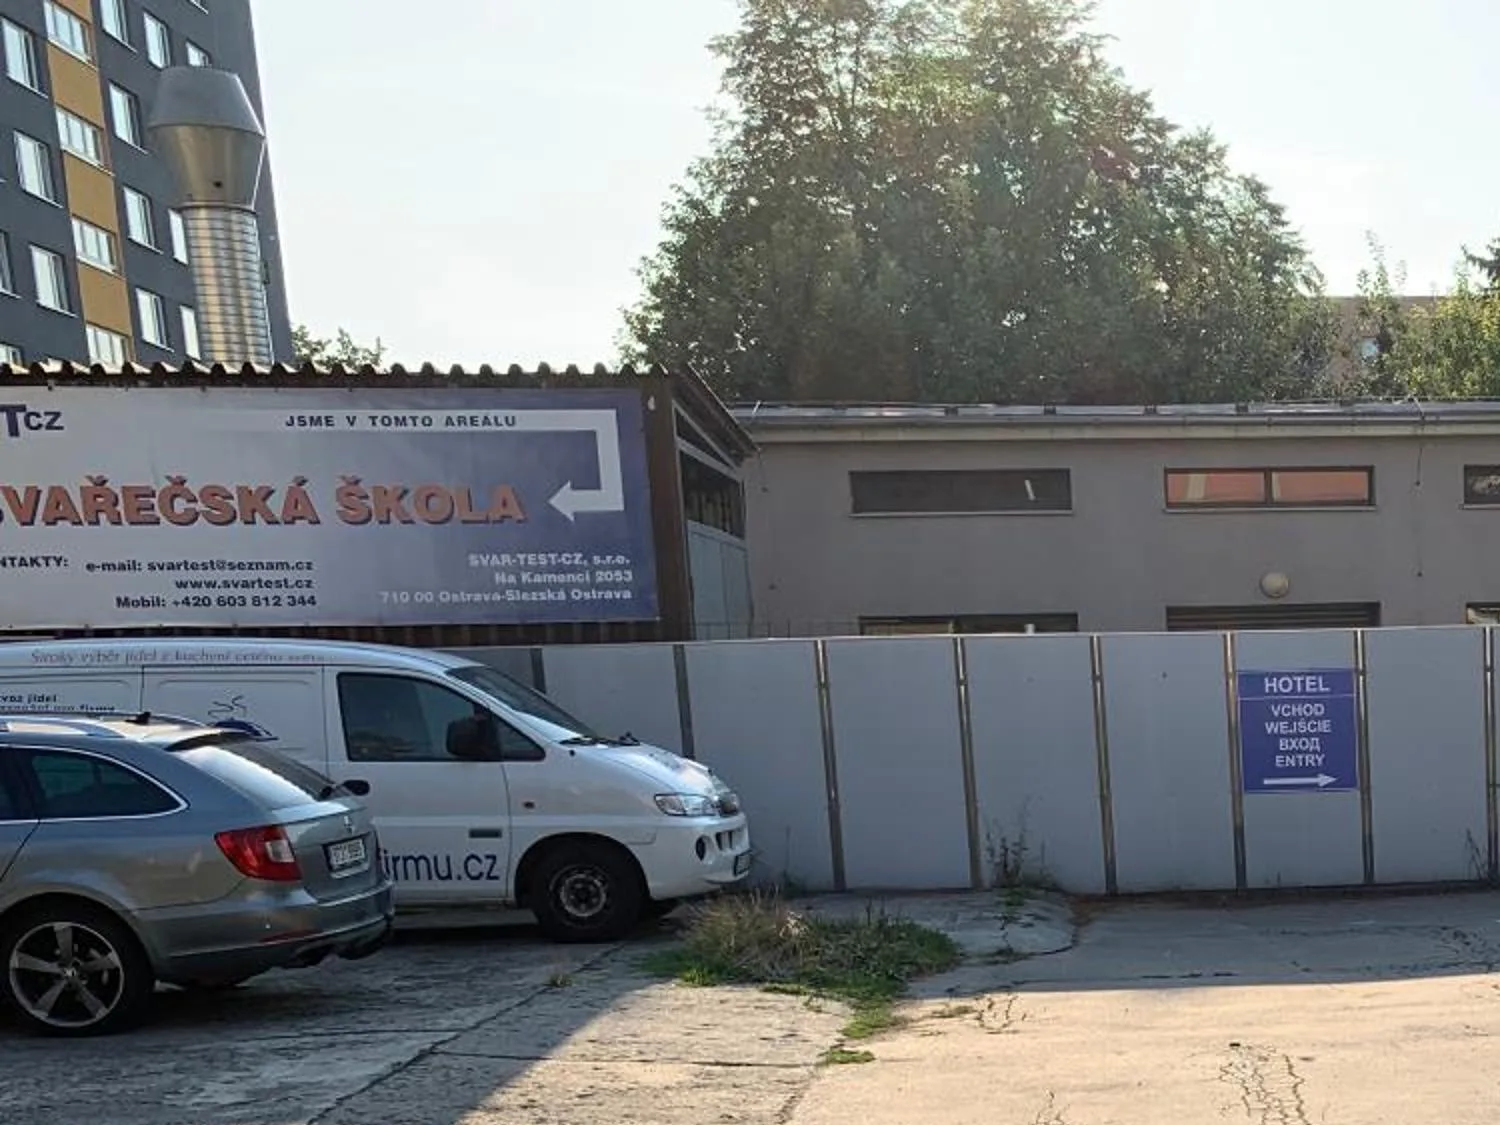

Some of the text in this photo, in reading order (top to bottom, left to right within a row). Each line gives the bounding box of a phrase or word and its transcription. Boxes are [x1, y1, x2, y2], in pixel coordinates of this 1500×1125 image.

[285, 415, 335, 427] JSME
[346, 415, 357, 427] V
[369, 415, 433, 427] TOMTO
[0, 475, 527, 526] VAŘEČSKÁ ŠKOLA
[85, 559, 314, 572] e-mail: svartest@seznam.cz
[175, 577, 314, 589] www.svartest.cz
[116, 595, 317, 608] Mobil: +420 603 812 344
[1264, 676, 1331, 693] HOTEL
[1271, 703, 1325, 717] VCHOD
[1275, 754, 1325, 768] ENTRY
